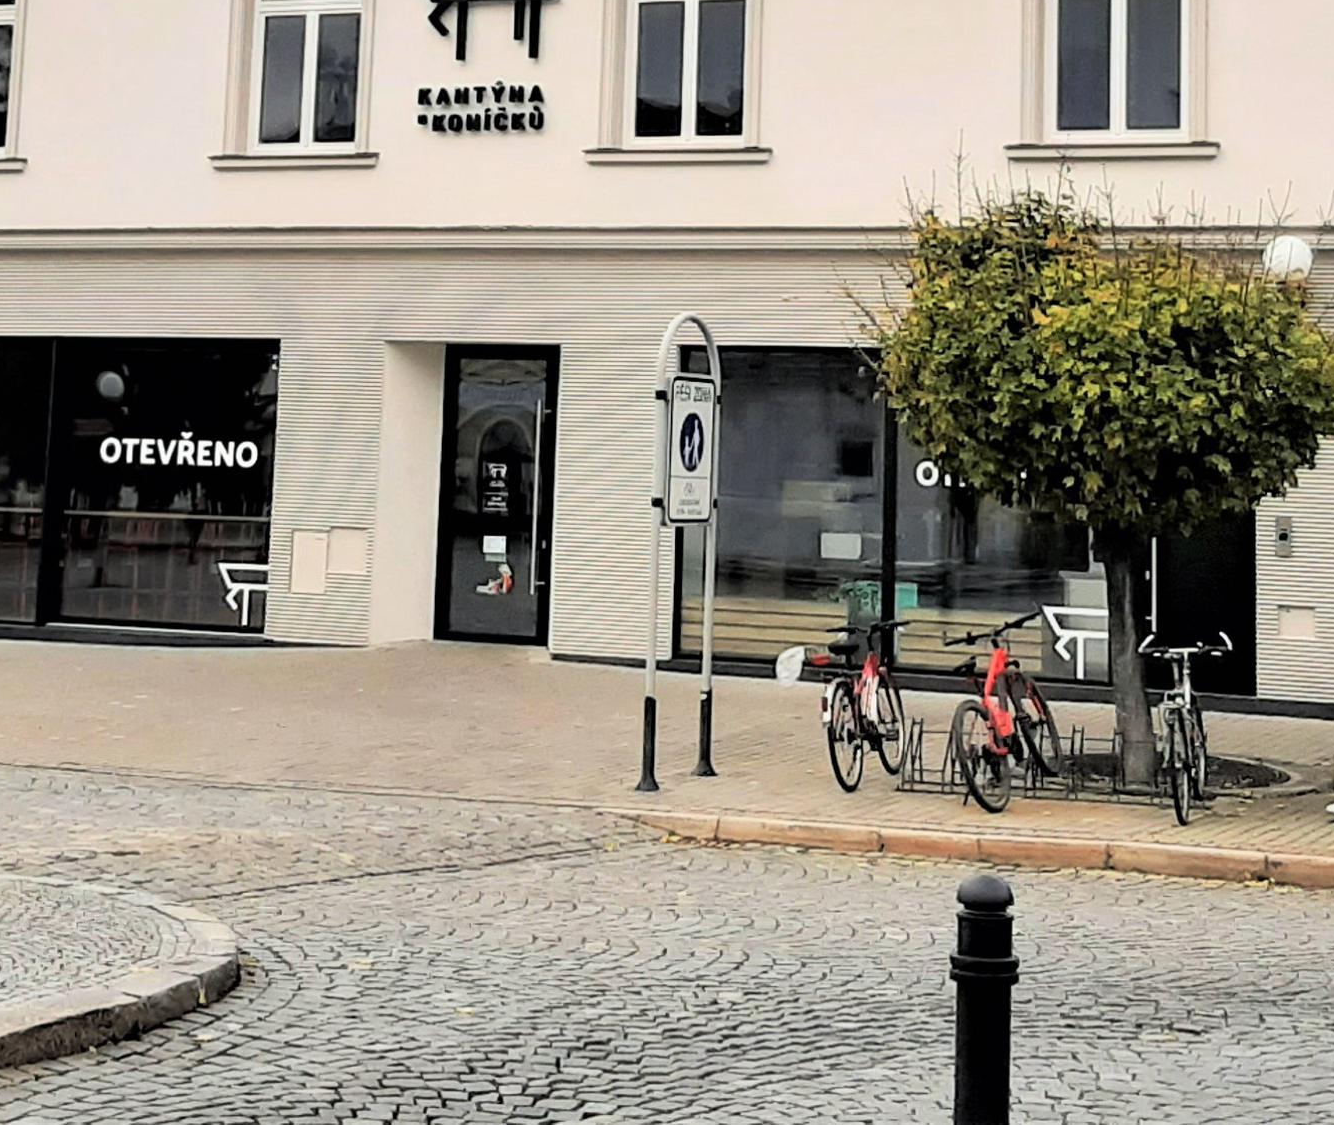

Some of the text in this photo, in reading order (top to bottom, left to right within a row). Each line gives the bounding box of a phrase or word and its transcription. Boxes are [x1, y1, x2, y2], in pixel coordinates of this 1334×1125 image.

[417, 80, 545, 106] KANTÝNA
[432, 105, 545, 132] KONÍČKŮ
[99, 431, 259, 469] OTEVŘENO
